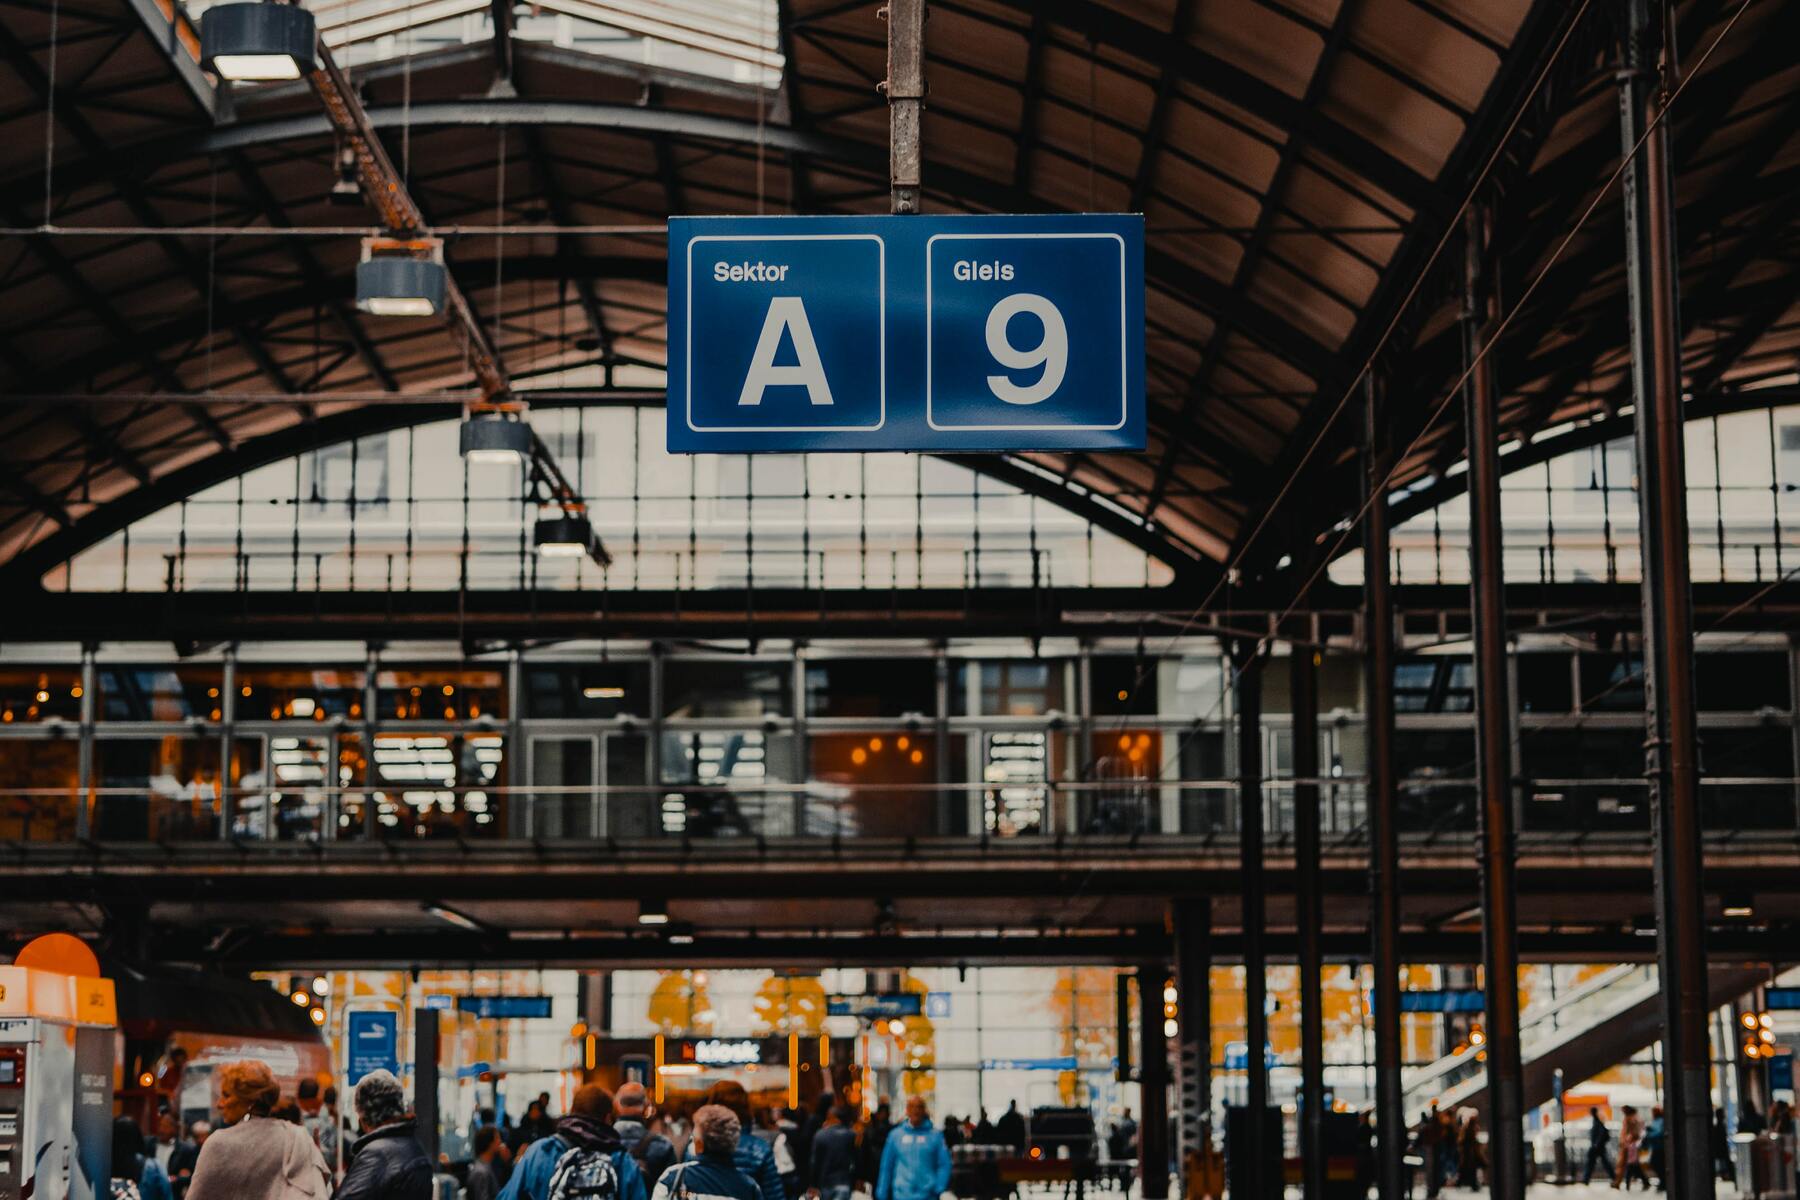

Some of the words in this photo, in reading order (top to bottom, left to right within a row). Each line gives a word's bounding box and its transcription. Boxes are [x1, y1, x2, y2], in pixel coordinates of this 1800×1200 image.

[714, 261, 789, 282] Sektor
[954, 260, 1015, 281] Gleis
[737, 296, 834, 406] A
[985, 293, 1069, 405] 9
